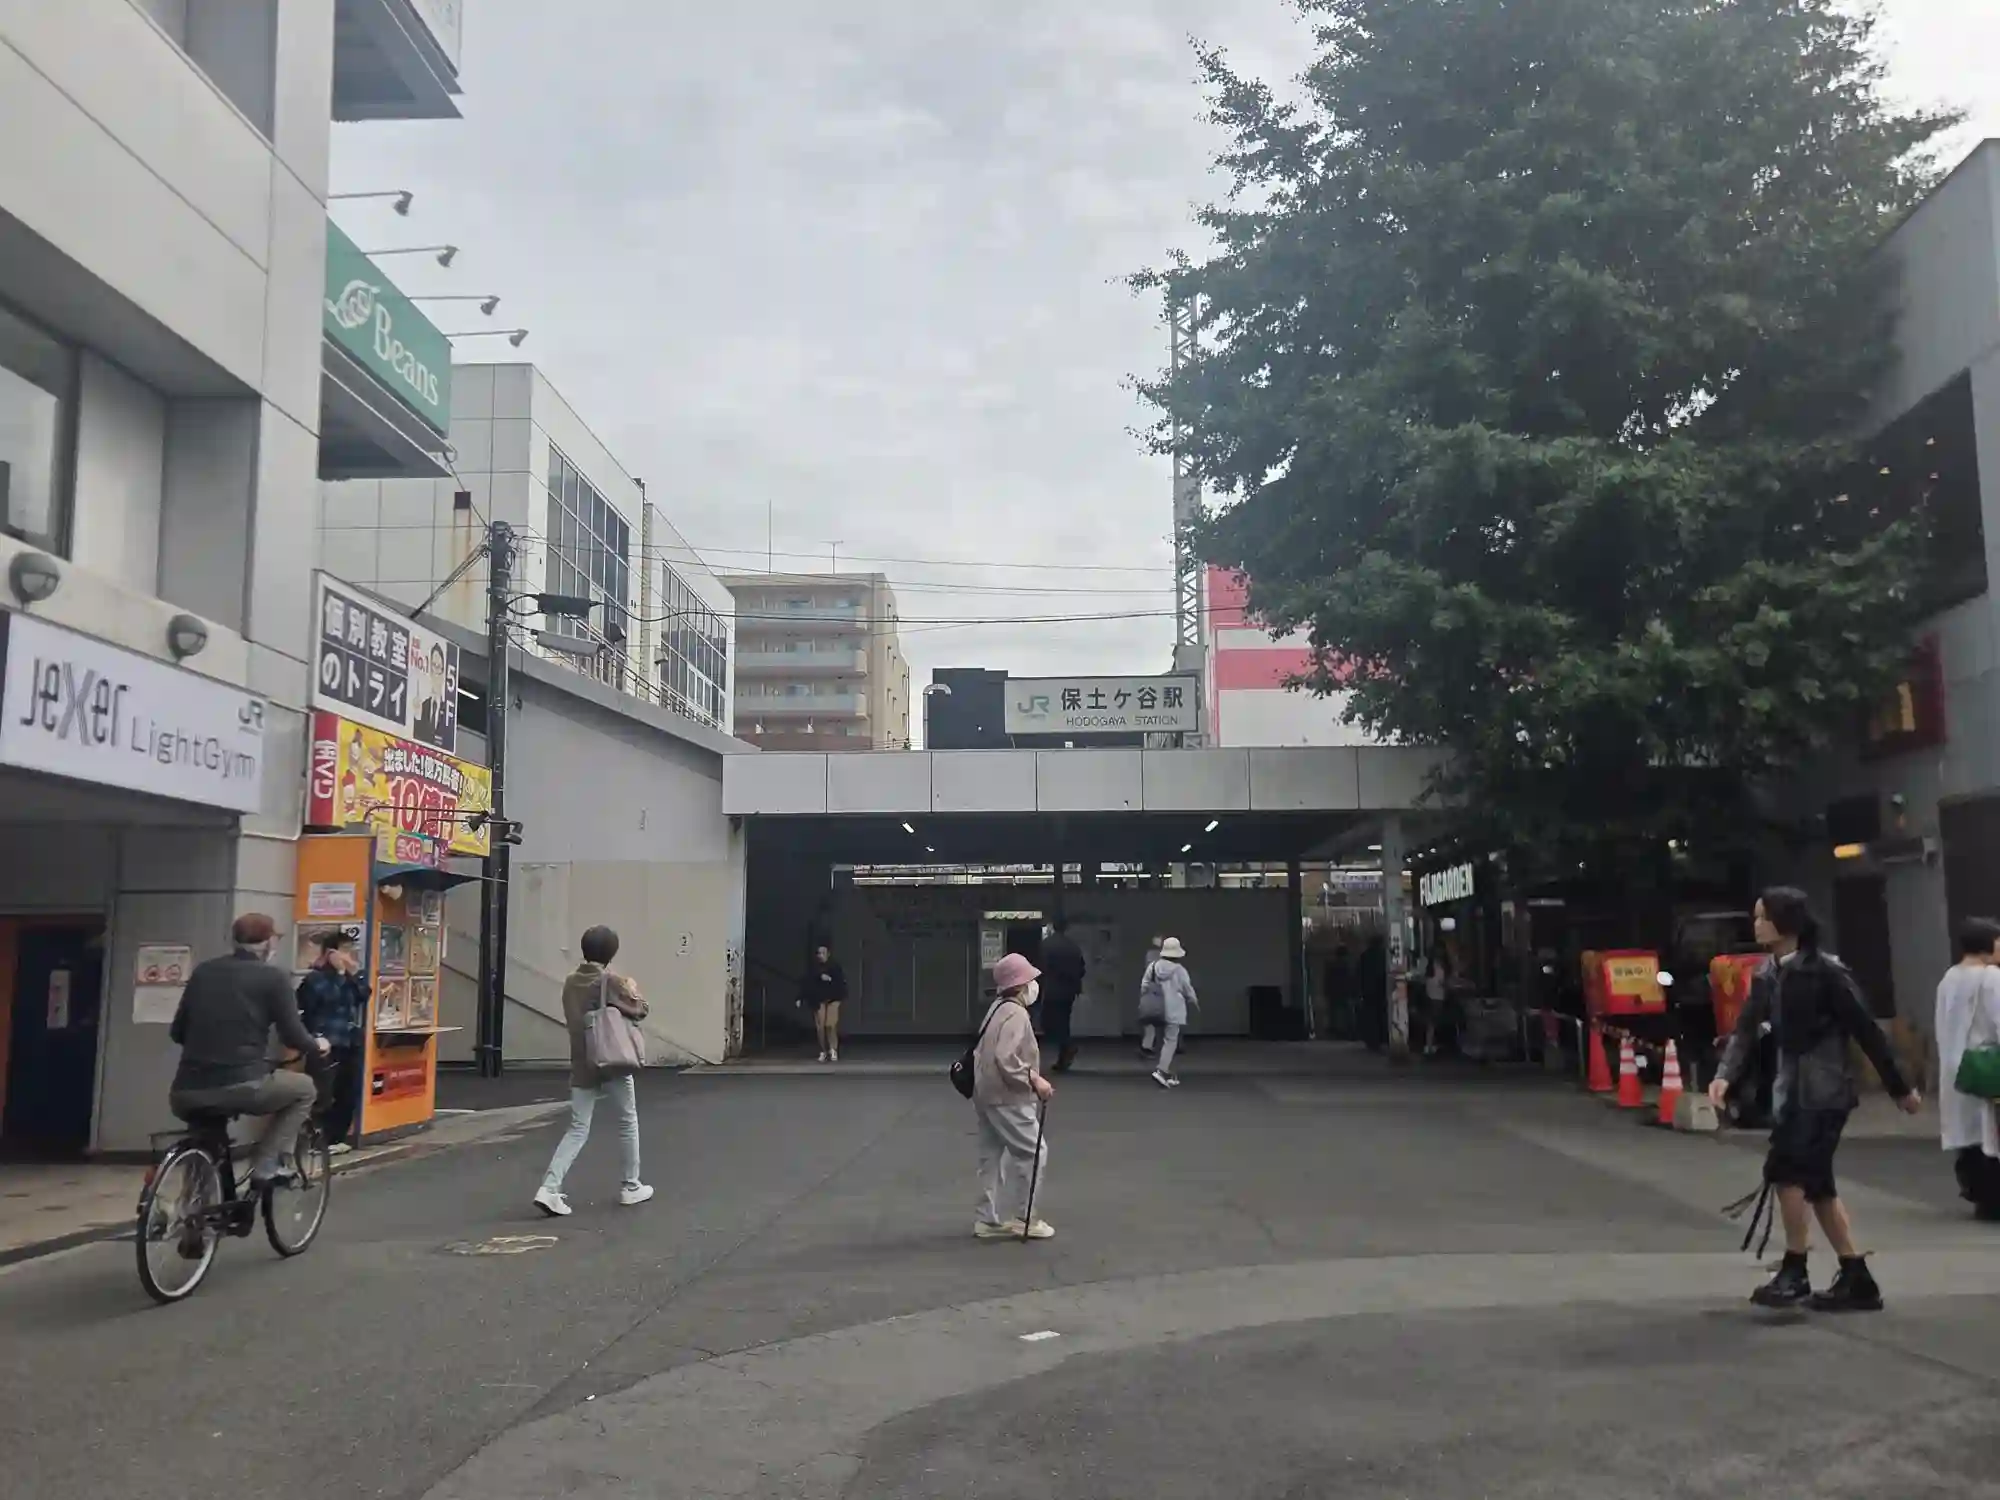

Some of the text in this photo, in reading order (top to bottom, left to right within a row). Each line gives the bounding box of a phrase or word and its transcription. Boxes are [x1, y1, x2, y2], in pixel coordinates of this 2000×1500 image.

[373, 301, 439, 406] Beans
[325, 594, 408, 670] 個別教室
[322, 652, 405, 717] のトライ
[1017, 695, 1050, 714] JR
[238, 699, 263, 729] JR
[1066, 716, 1179, 727] HODOGAYA STATION
